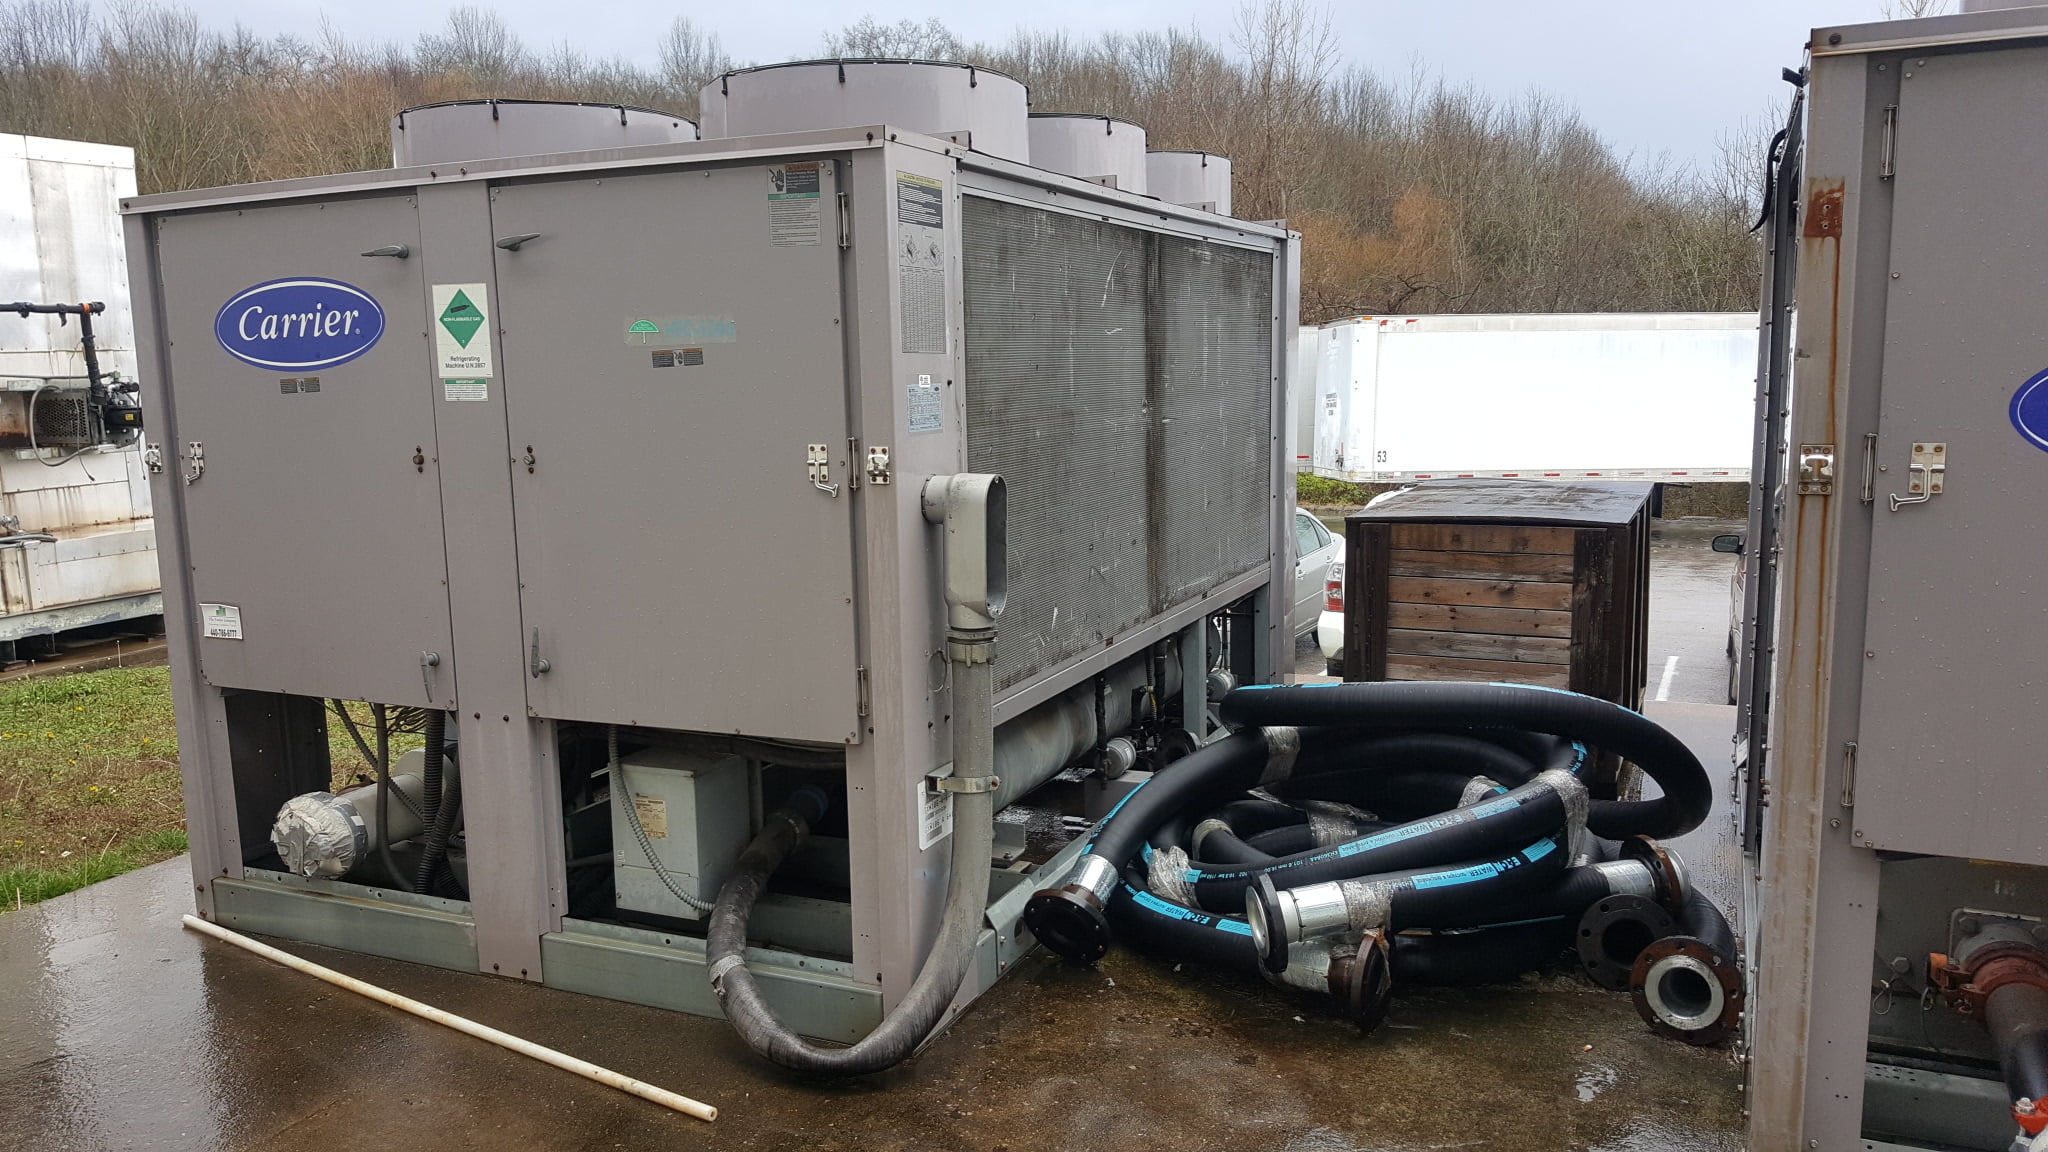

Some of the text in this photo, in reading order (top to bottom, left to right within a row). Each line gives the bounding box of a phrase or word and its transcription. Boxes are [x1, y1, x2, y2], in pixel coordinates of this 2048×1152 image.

[238, 302, 359, 341] Carrier
[1377, 450, 1387, 463] 53
[1399, 823, 1430, 837] WATER
[1469, 863, 1496, 878] WATER
[1494, 856, 1522, 873] EATON
[1166, 905, 1185, 918] WATER
